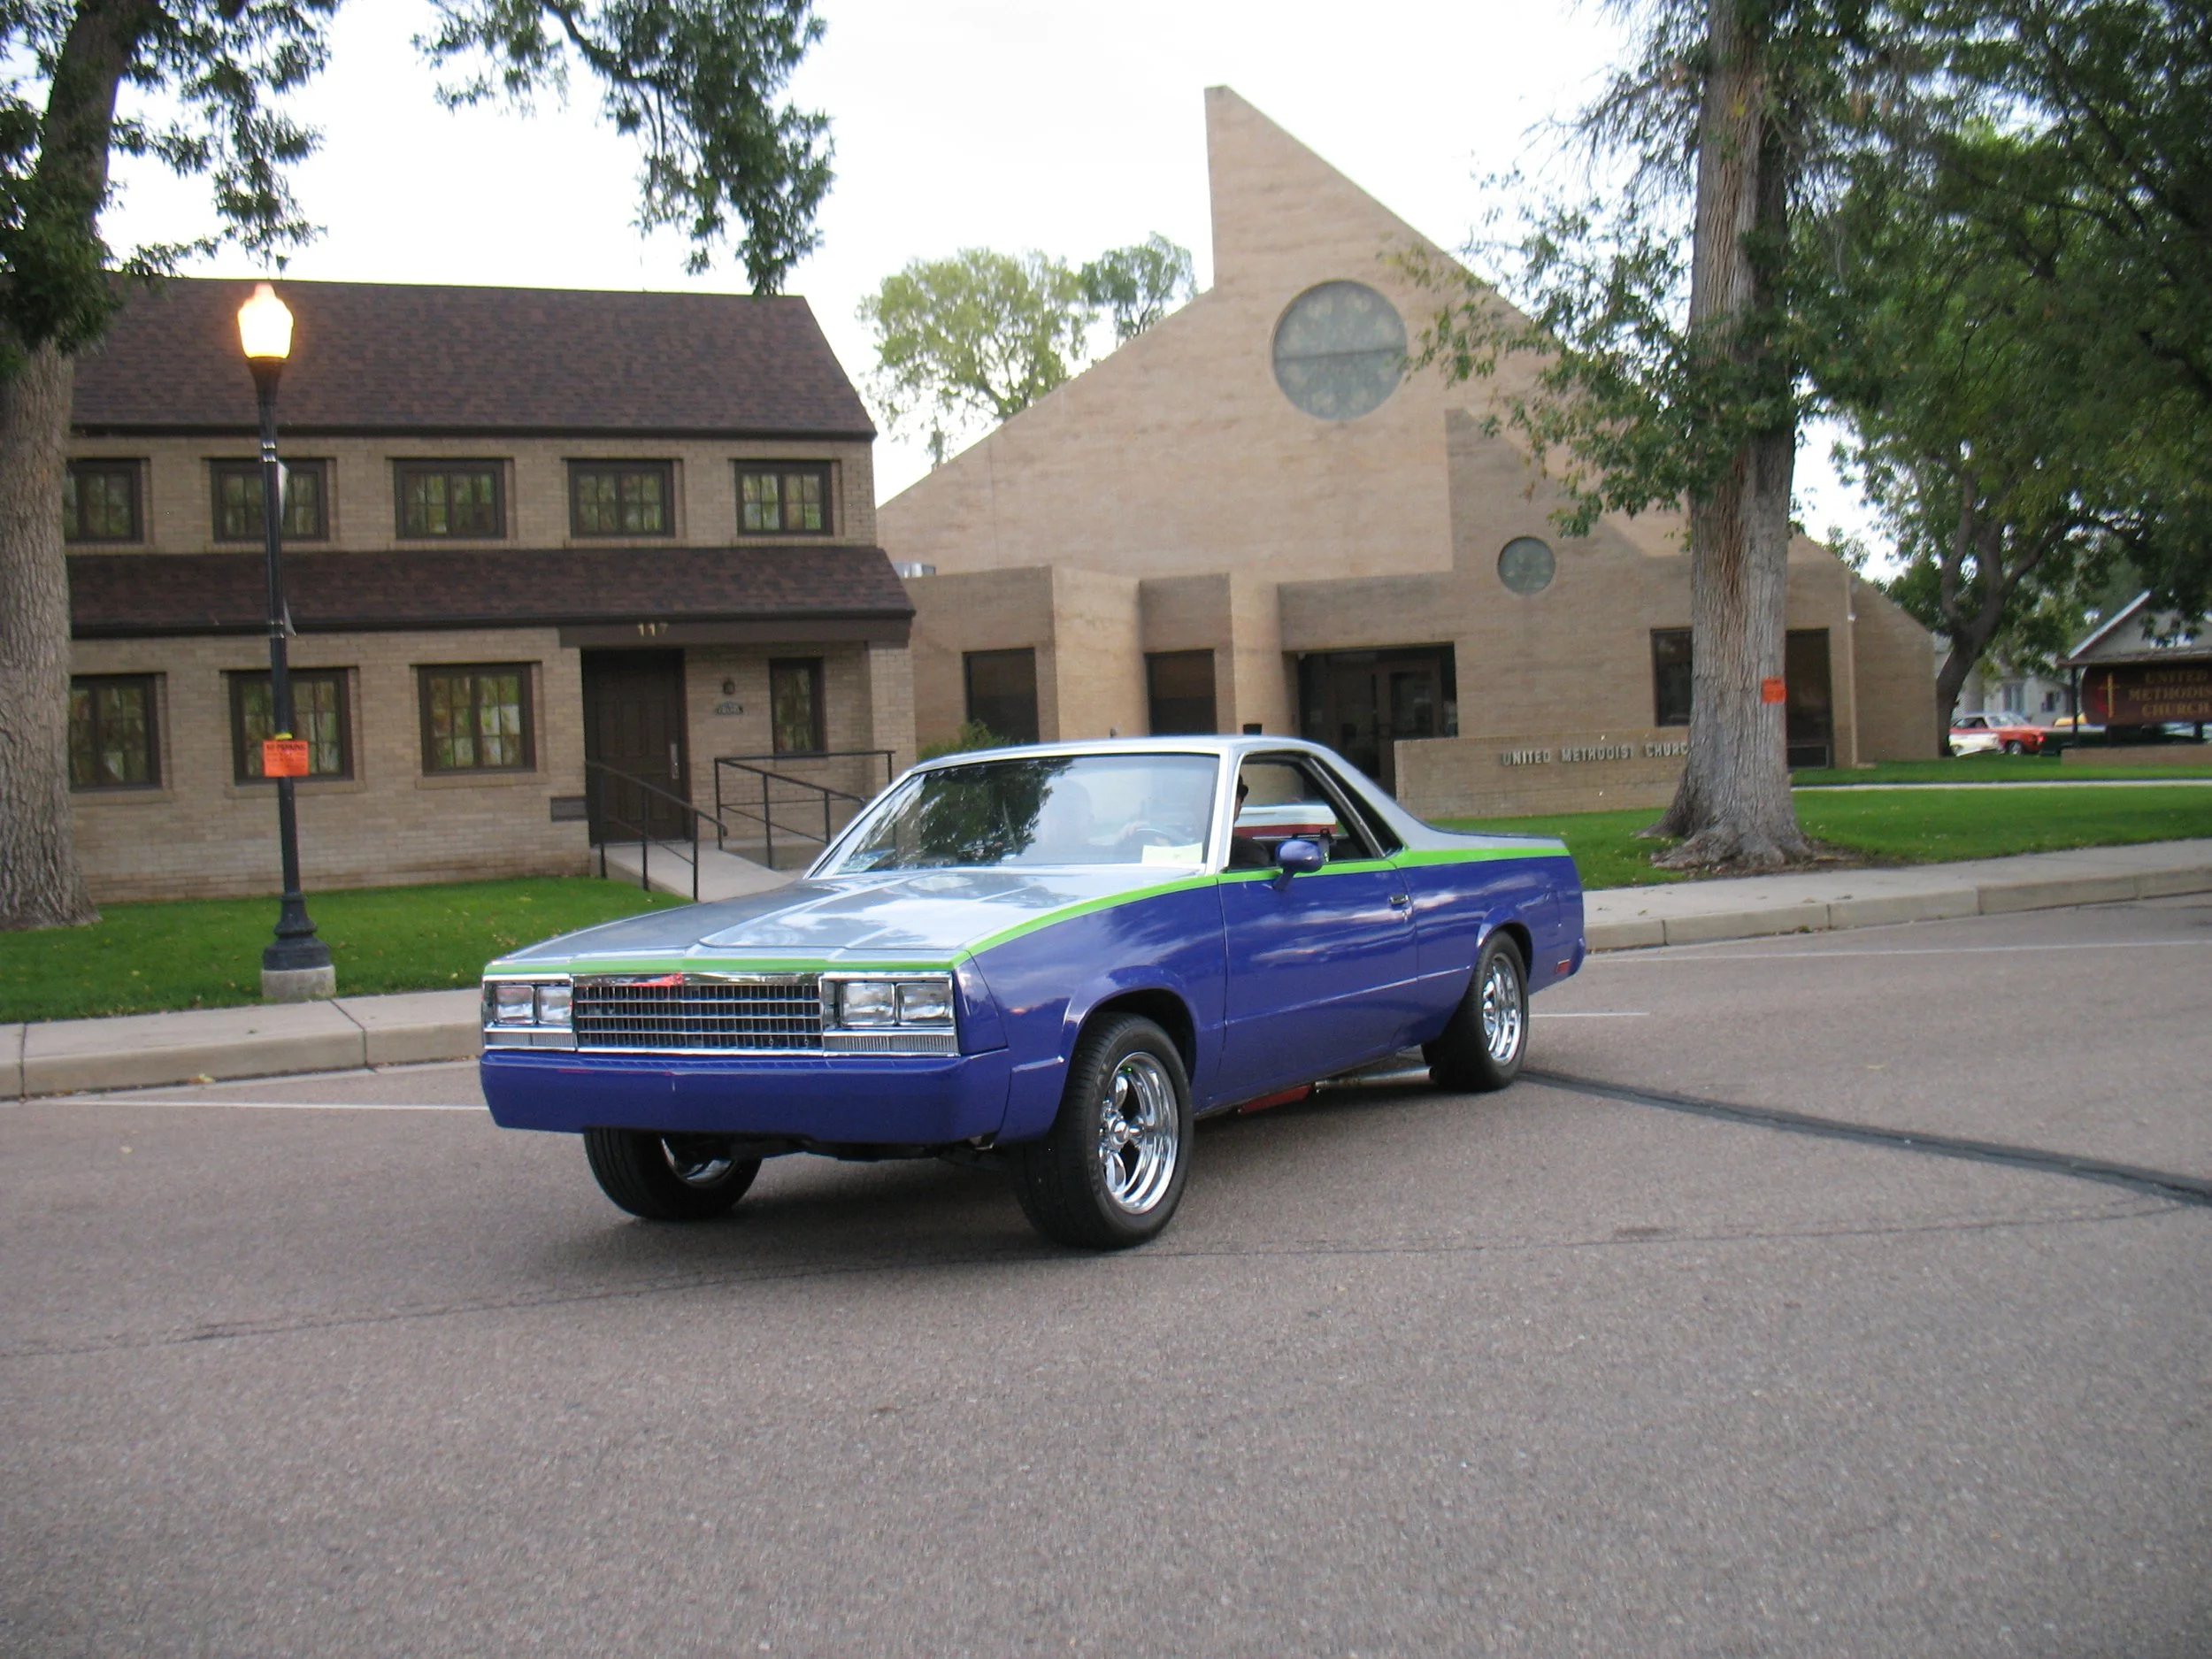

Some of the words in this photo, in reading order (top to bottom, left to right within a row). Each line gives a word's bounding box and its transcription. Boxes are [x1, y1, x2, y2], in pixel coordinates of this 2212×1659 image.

[637, 622, 669, 637] 117
[2145, 670, 2209, 684] UNITED
[2128, 686, 2212, 701] METHODIS
[2141, 702, 2210, 718] CHURCH
[1502, 749, 1551, 765] UNITED
[1561, 744, 1635, 763] METHODIST
[1644, 741, 1689, 758] CHURC
